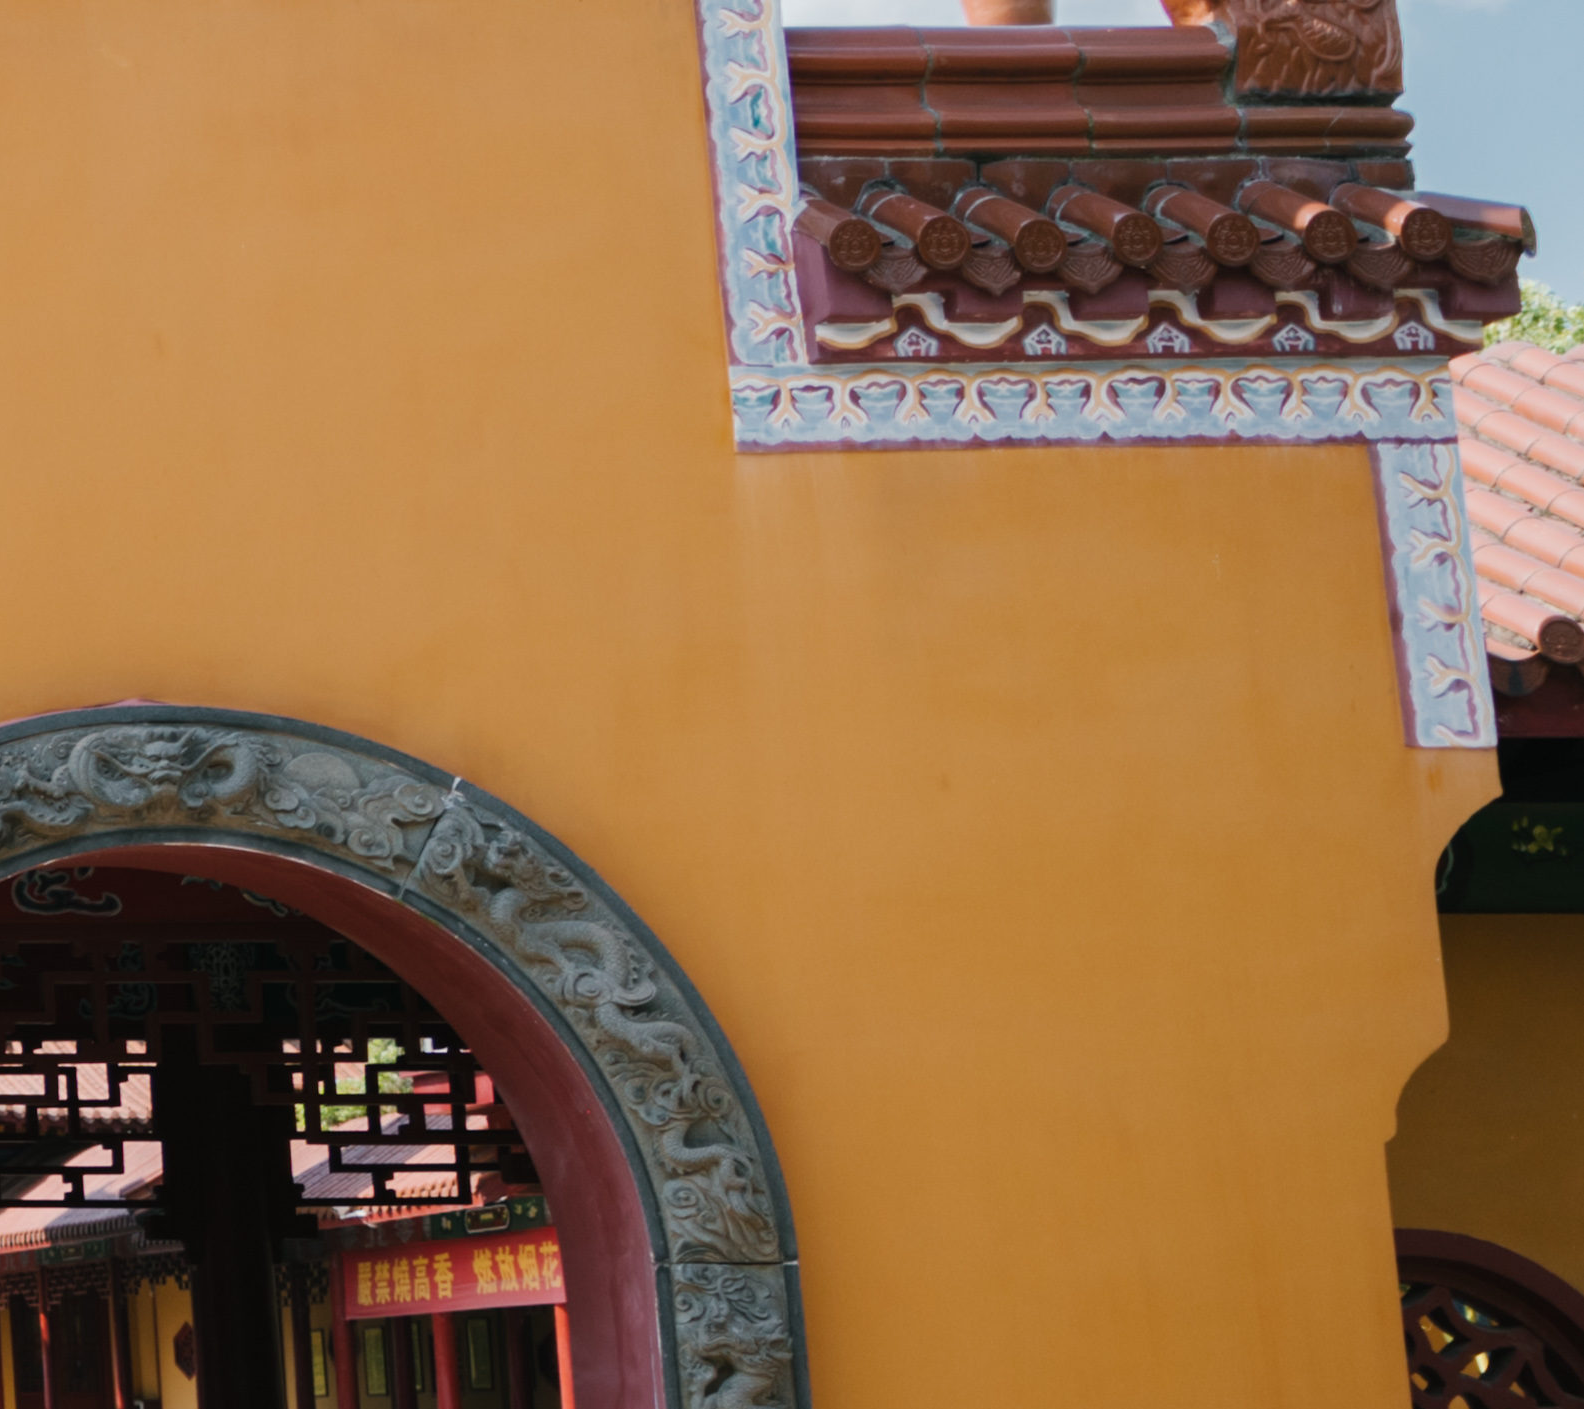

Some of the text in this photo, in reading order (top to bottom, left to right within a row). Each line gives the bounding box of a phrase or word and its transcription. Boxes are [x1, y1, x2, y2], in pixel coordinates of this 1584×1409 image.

[357, 1252, 454, 1306] 嚴禁燒高香
